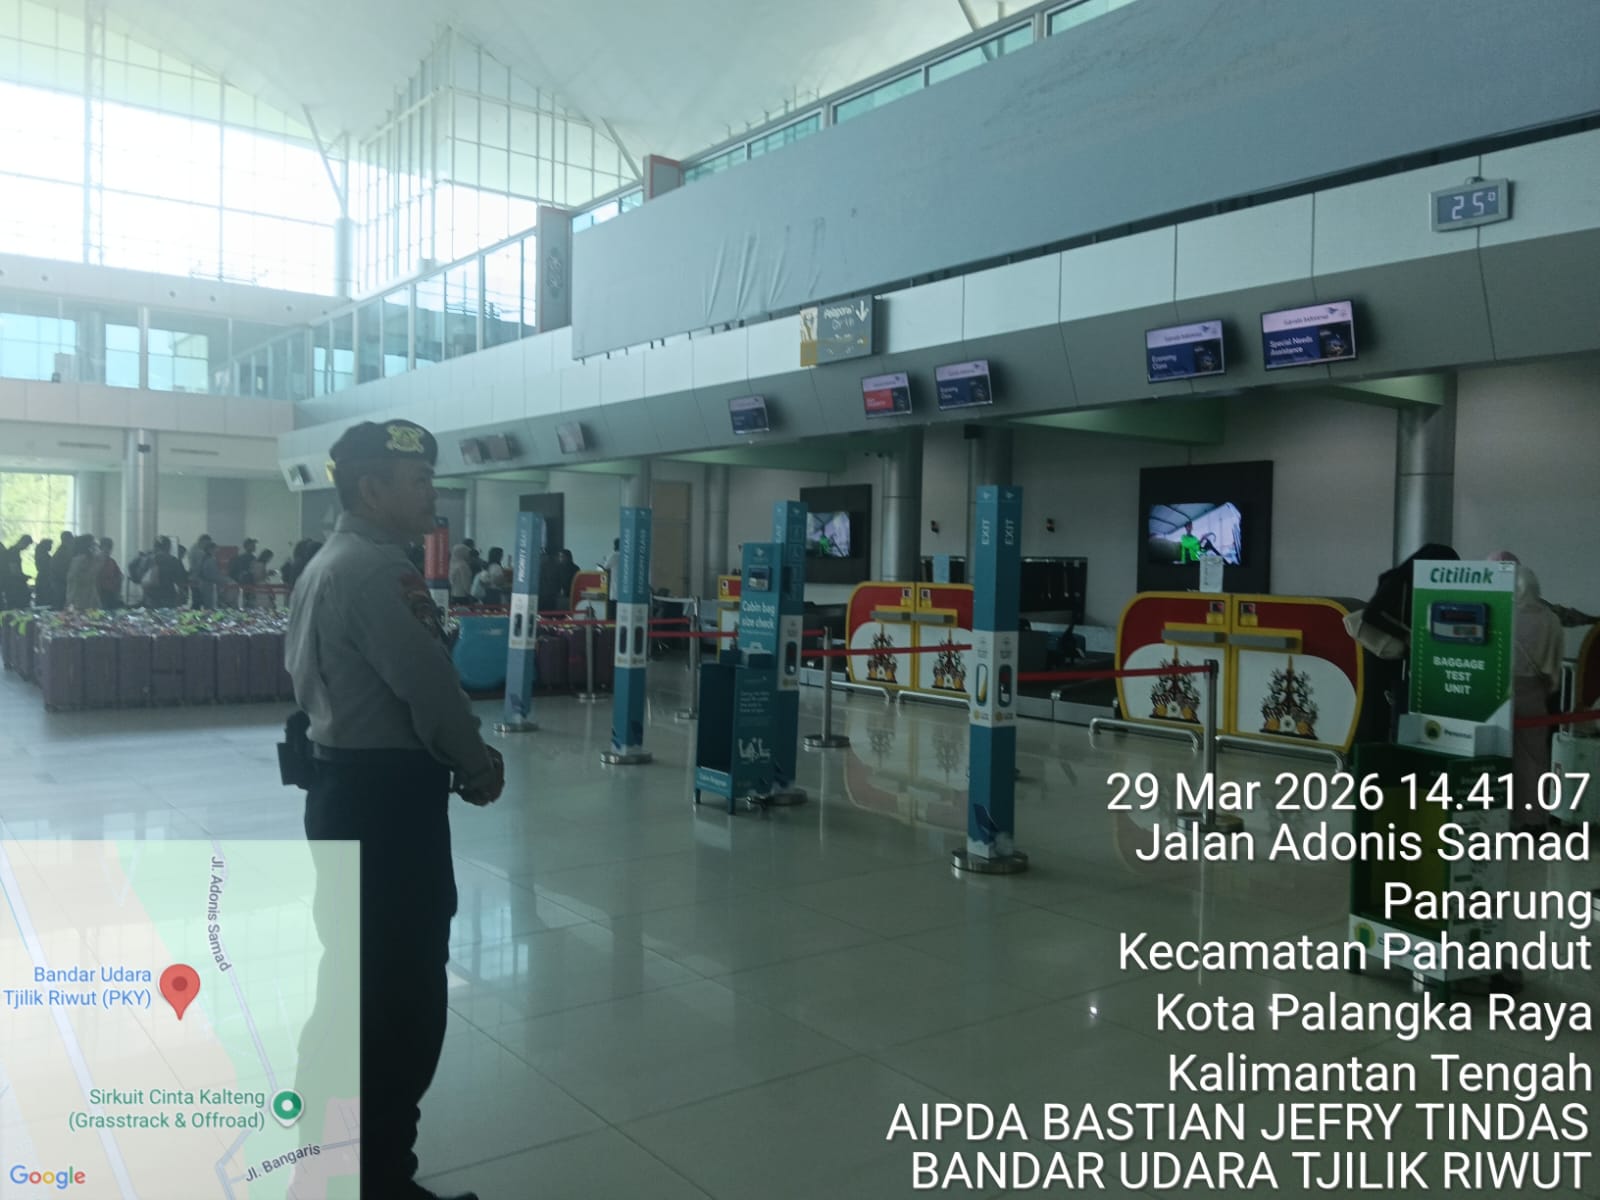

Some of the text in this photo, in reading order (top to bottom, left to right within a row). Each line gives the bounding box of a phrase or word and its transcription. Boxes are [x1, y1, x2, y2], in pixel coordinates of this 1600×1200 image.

[981, 519, 991, 545] EXIT
[1004, 519, 1015, 545] EXIT
[1430, 567, 1494, 584] Citilink
[1433, 656, 1485, 670] BAGGAGE
[1445, 670, 1472, 682] TEST
[1444, 683, 1472, 695] UNIT
